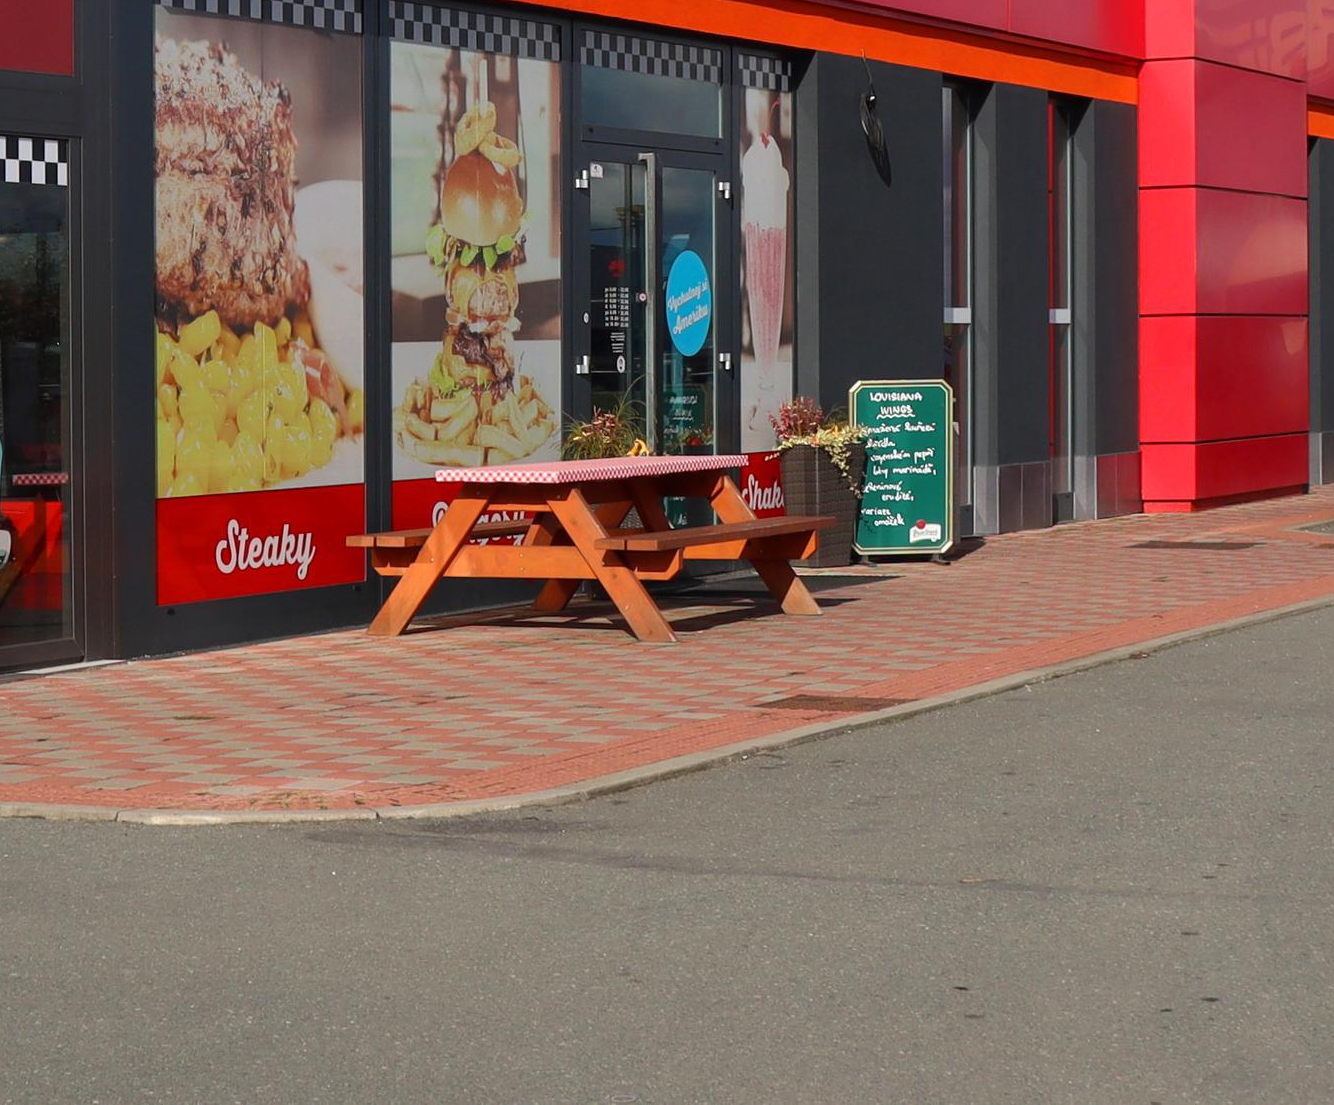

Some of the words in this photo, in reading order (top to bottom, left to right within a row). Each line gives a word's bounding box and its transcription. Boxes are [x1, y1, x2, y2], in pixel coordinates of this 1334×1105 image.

[869, 391, 923, 402] LOUISIANA
[880, 404, 914, 415] WINGS
[741, 473, 785, 511] Shak
[215, 518, 316, 581] Steaky
